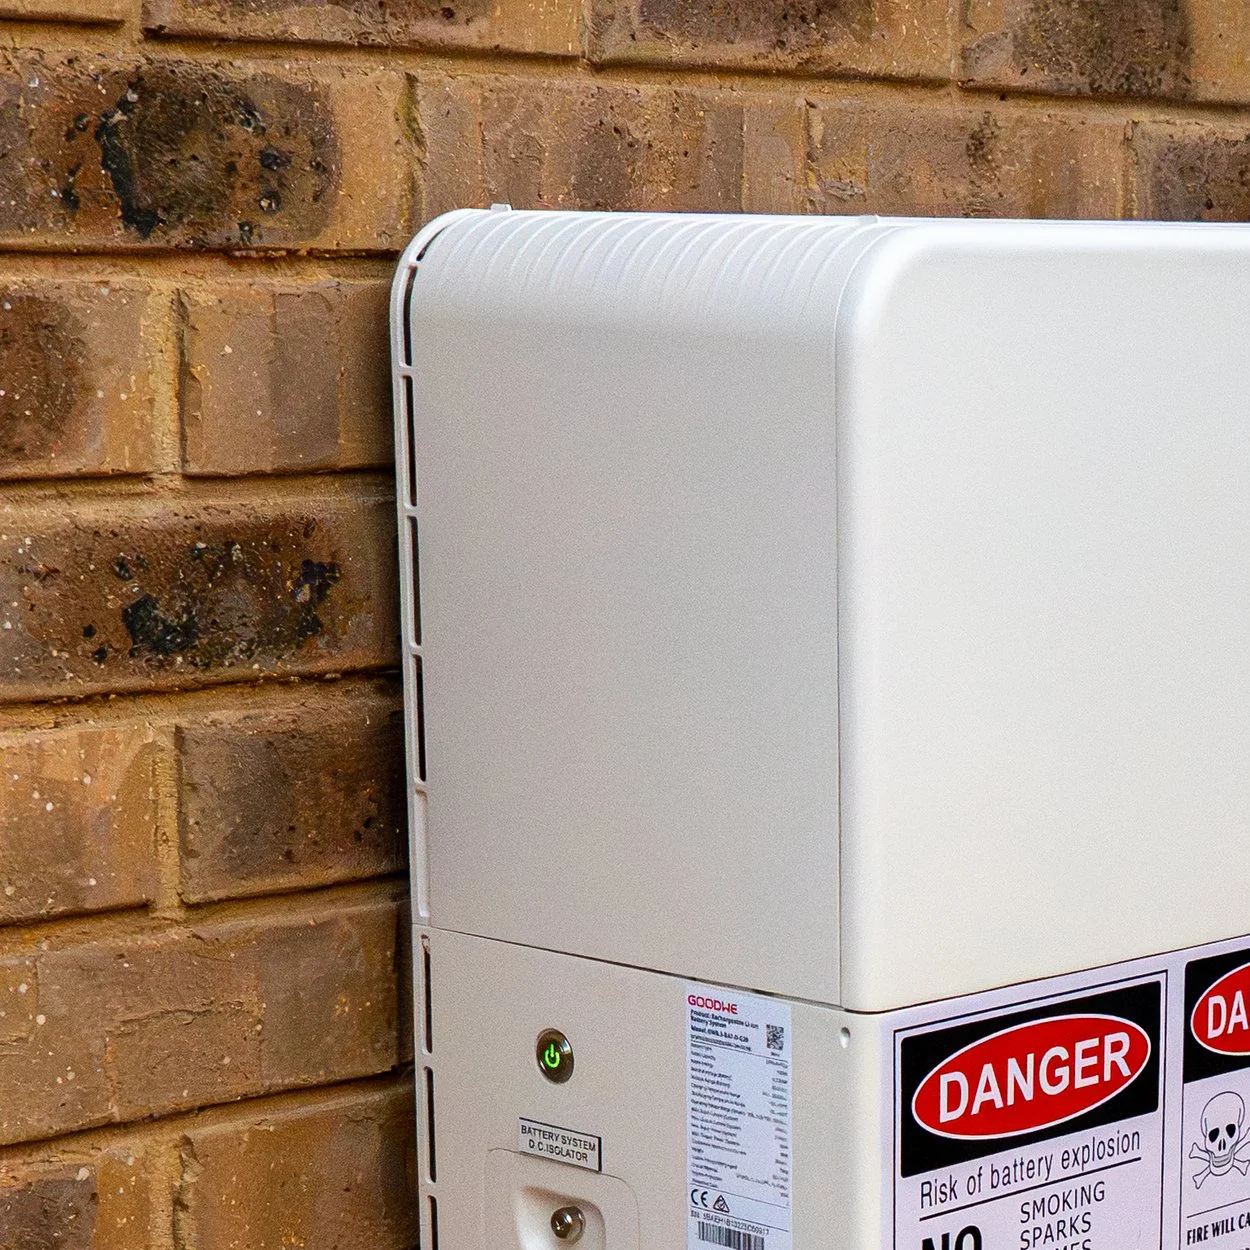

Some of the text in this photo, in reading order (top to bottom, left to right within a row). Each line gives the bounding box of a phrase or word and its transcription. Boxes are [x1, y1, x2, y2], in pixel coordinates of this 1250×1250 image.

[688, 994, 738, 1014] GOODWE
[938, 1032, 1132, 1124] DANGER
[521, 1124, 596, 1151] BATTERY SYSTEM
[920, 1130, 1140, 1208] Risk of battery explosion
[1020, 1181, 1106, 1224] SMOKING
[1020, 1212, 1092, 1250] SPARKS
[1186, 1224, 1208, 1245] FIRE
[1212, 1217, 1236, 1238] WILL
